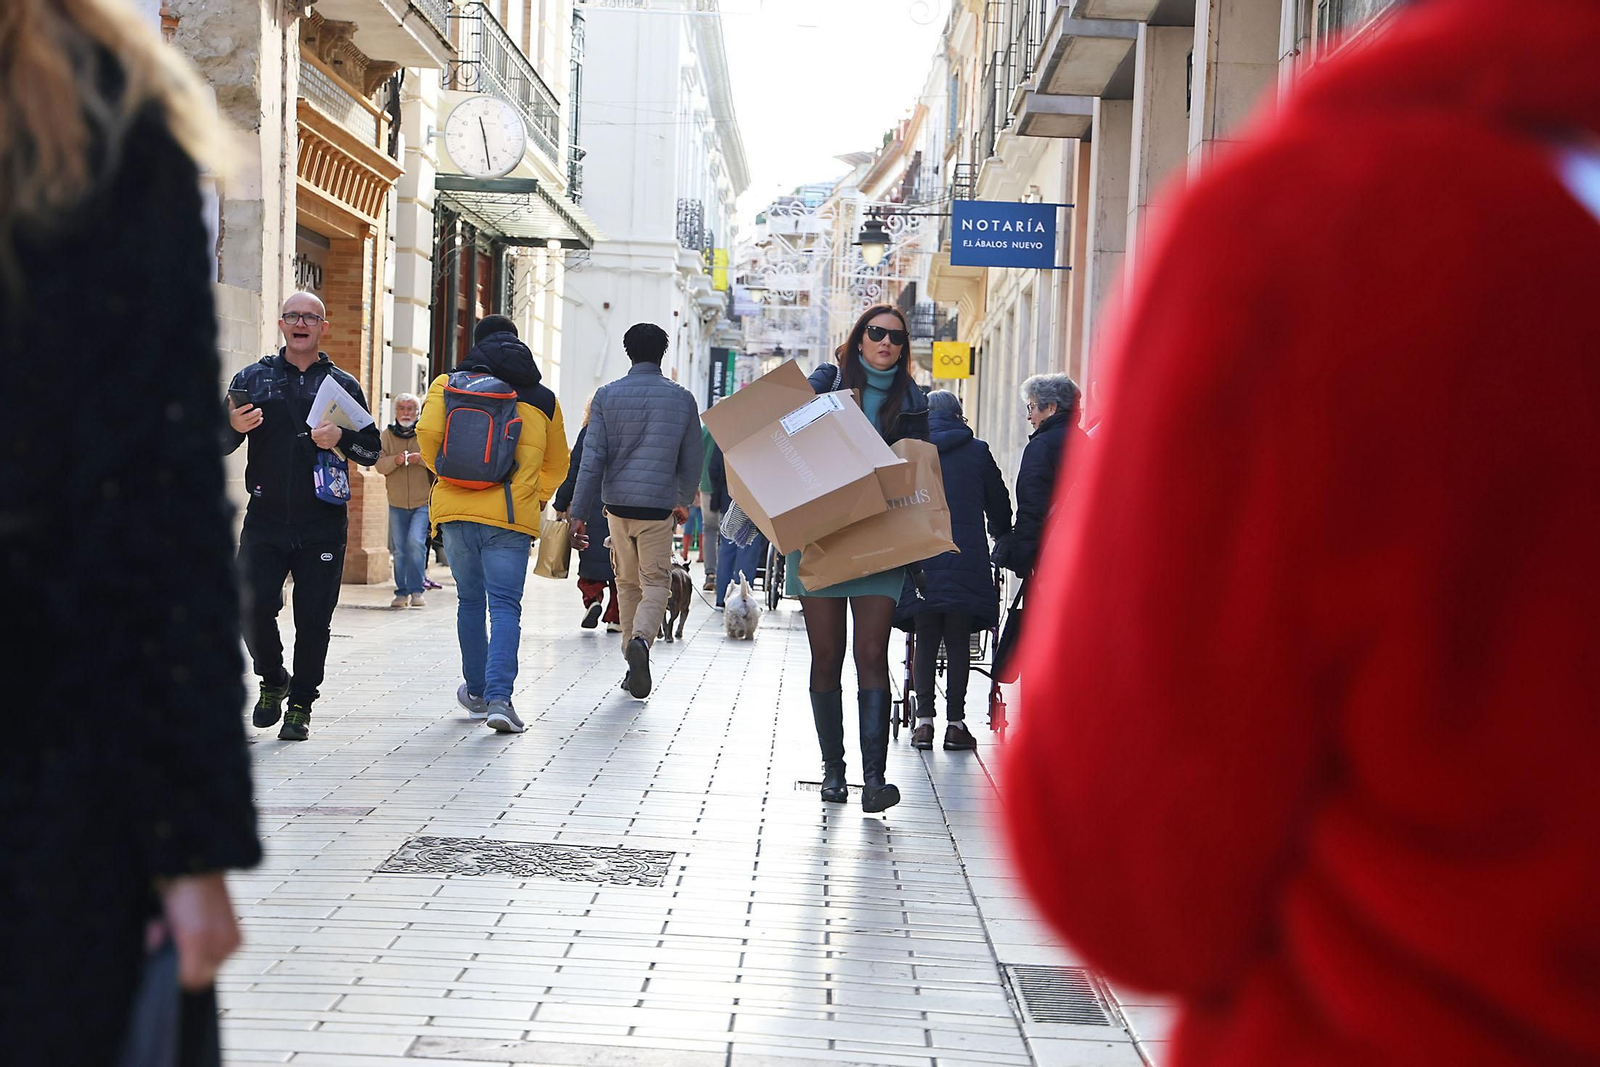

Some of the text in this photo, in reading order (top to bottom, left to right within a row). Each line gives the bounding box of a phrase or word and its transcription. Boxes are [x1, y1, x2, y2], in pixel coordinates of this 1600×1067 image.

[961, 217, 1045, 233] NOTARÍA
[974, 238, 1008, 249] ÁBALOS
[1011, 241, 1043, 250] NUEVO
[713, 362, 722, 387] BIMBA
